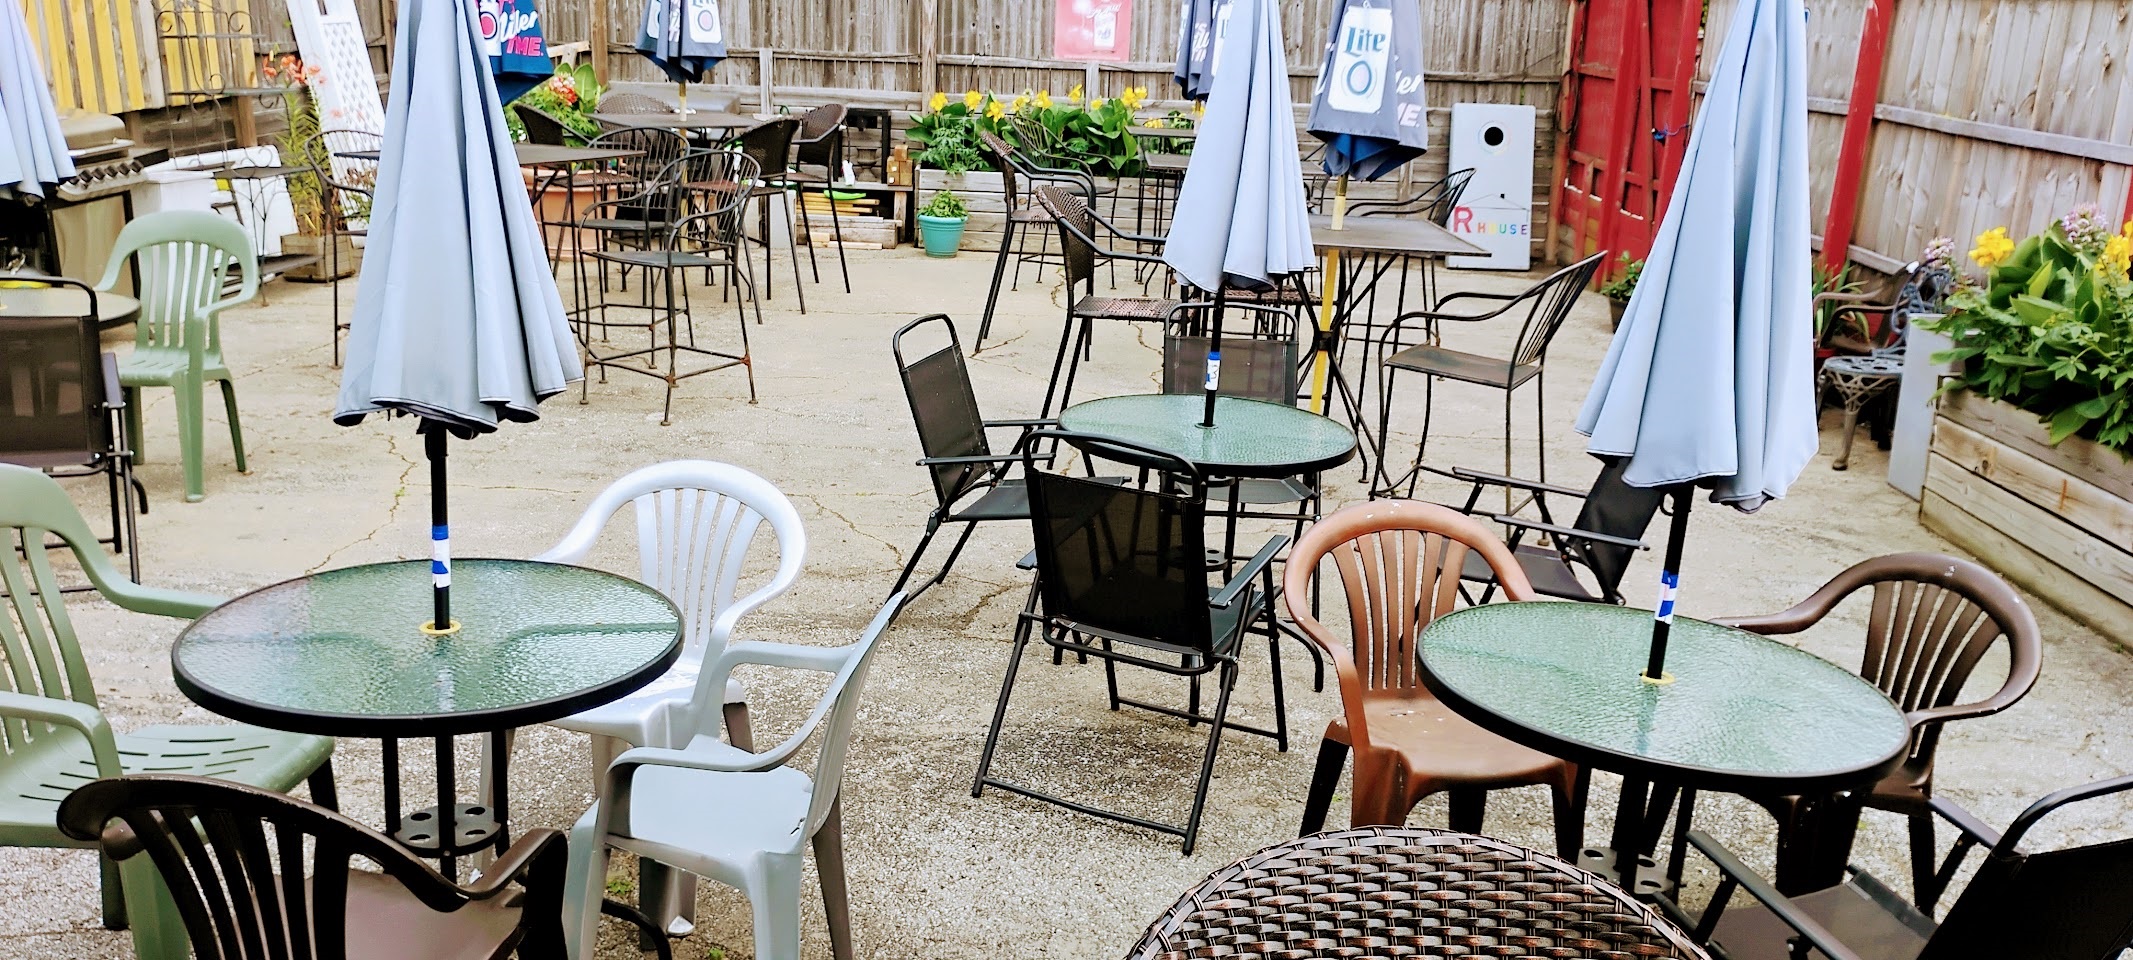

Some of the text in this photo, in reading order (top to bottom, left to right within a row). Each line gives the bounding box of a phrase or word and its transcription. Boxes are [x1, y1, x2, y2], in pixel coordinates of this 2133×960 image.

[1344, 26, 1386, 58] Lite
[1453, 206, 1528, 235] R HOUSE
